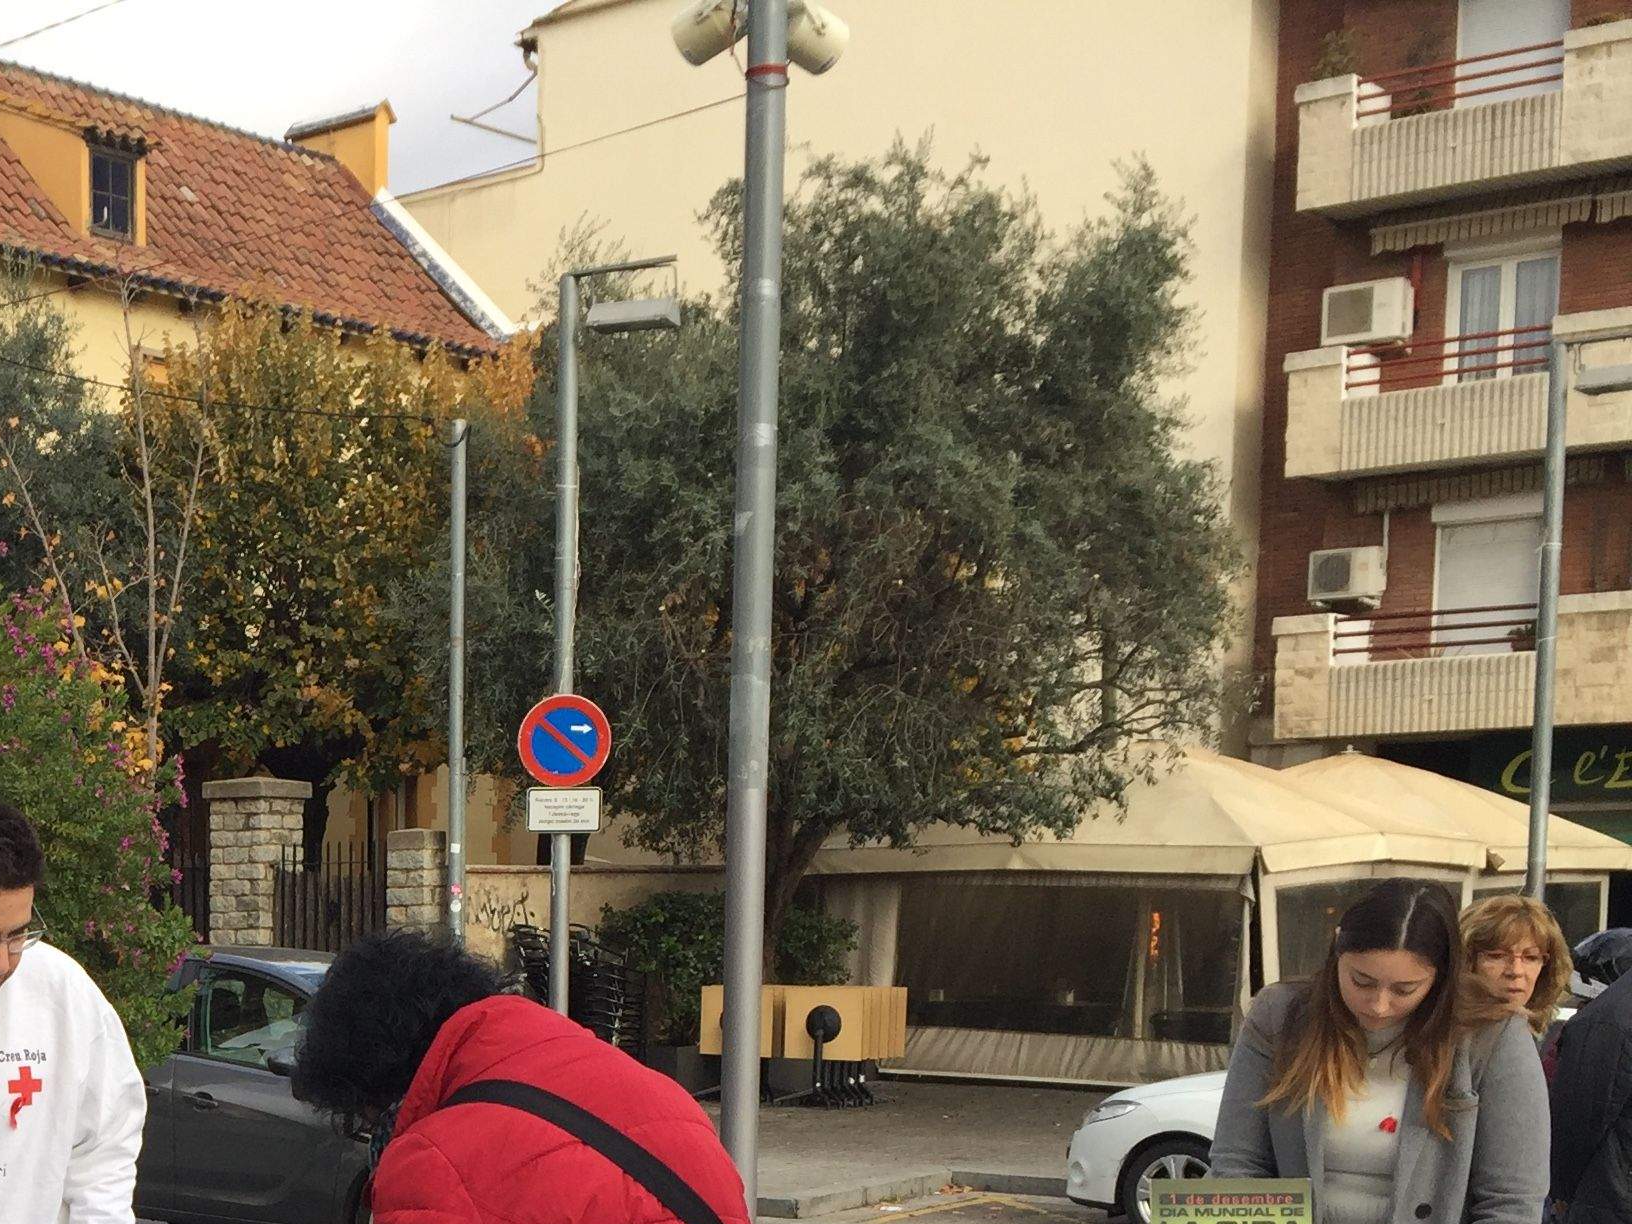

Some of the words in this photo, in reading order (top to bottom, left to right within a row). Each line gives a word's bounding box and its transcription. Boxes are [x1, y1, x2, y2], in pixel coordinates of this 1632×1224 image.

[24, 1049, 47, 1064] Roja
[1170, 1194, 1177, 1204] 1
[1185, 1194, 1205, 1205] de
[1211, 1194, 1292, 1206] desembre
[1159, 1207, 1188, 1217] DIA
[1194, 1207, 1275, 1217] MUNDIAL
[1280, 1206, 1305, 1217] DE
